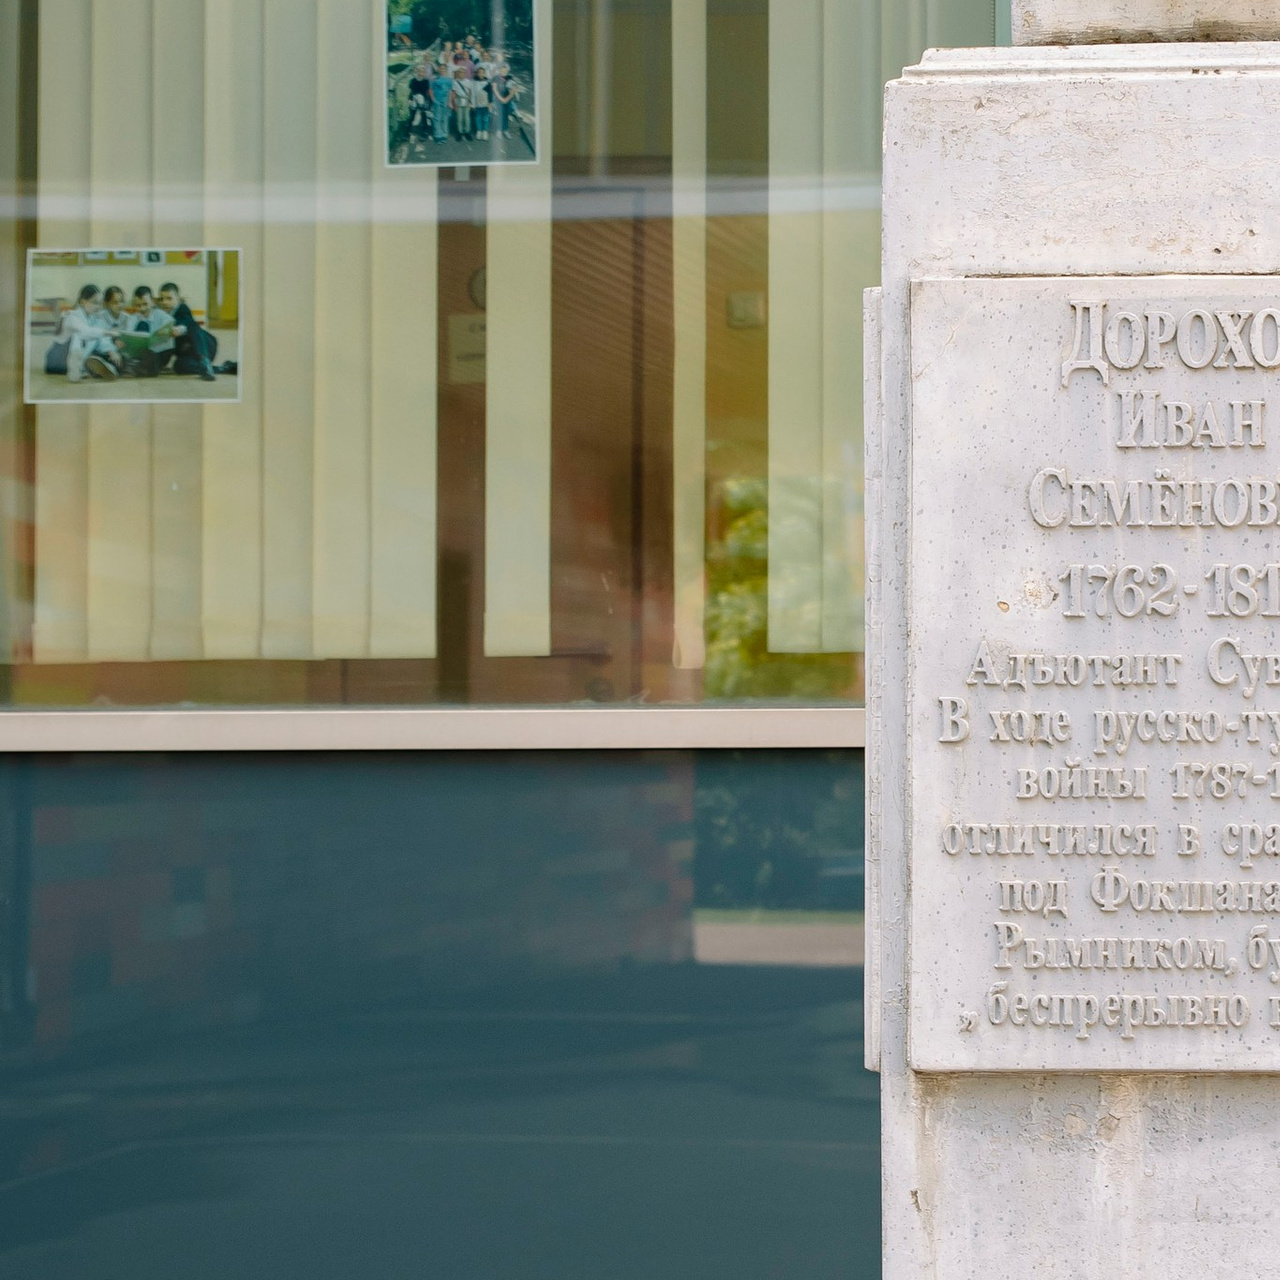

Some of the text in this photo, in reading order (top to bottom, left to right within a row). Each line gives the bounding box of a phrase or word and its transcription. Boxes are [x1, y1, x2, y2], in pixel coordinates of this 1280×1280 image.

[966, 639, 1182, 694] Адъютант
[938, 696, 970, 743] В
[989, 709, 1070, 747] ходе
[1016, 756, 1147, 800] войны
[942, 822, 1156, 856] отличился
[1178, 823, 1200, 856] в
[999, 879, 1067, 918] под
[994, 921, 1237, 976] Рымником,
